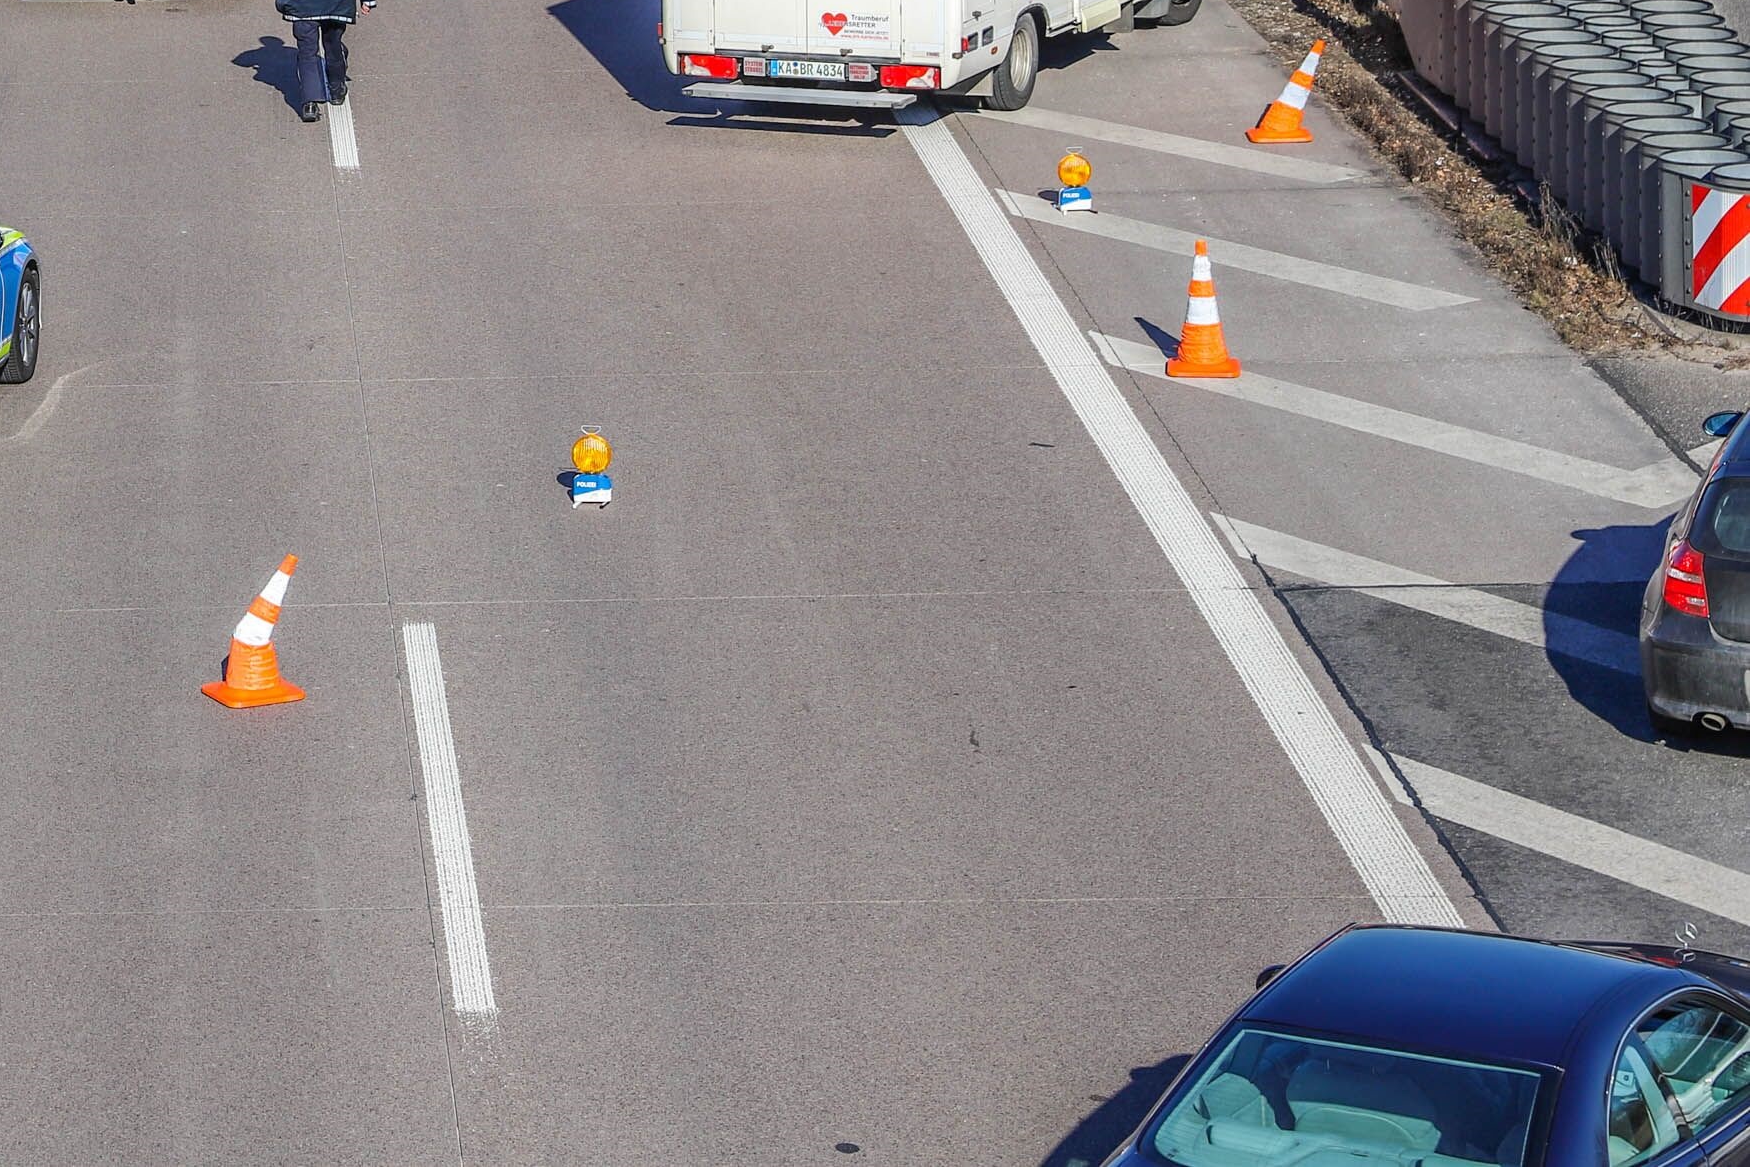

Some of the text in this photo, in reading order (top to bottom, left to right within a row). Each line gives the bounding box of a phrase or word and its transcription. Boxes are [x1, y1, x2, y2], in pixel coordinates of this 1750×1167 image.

[851, 14, 889, 22] Traumberuf
[778, 61, 792, 74] KA
[800, 62, 814, 75] BR
[816, 63, 843, 77] 4834
